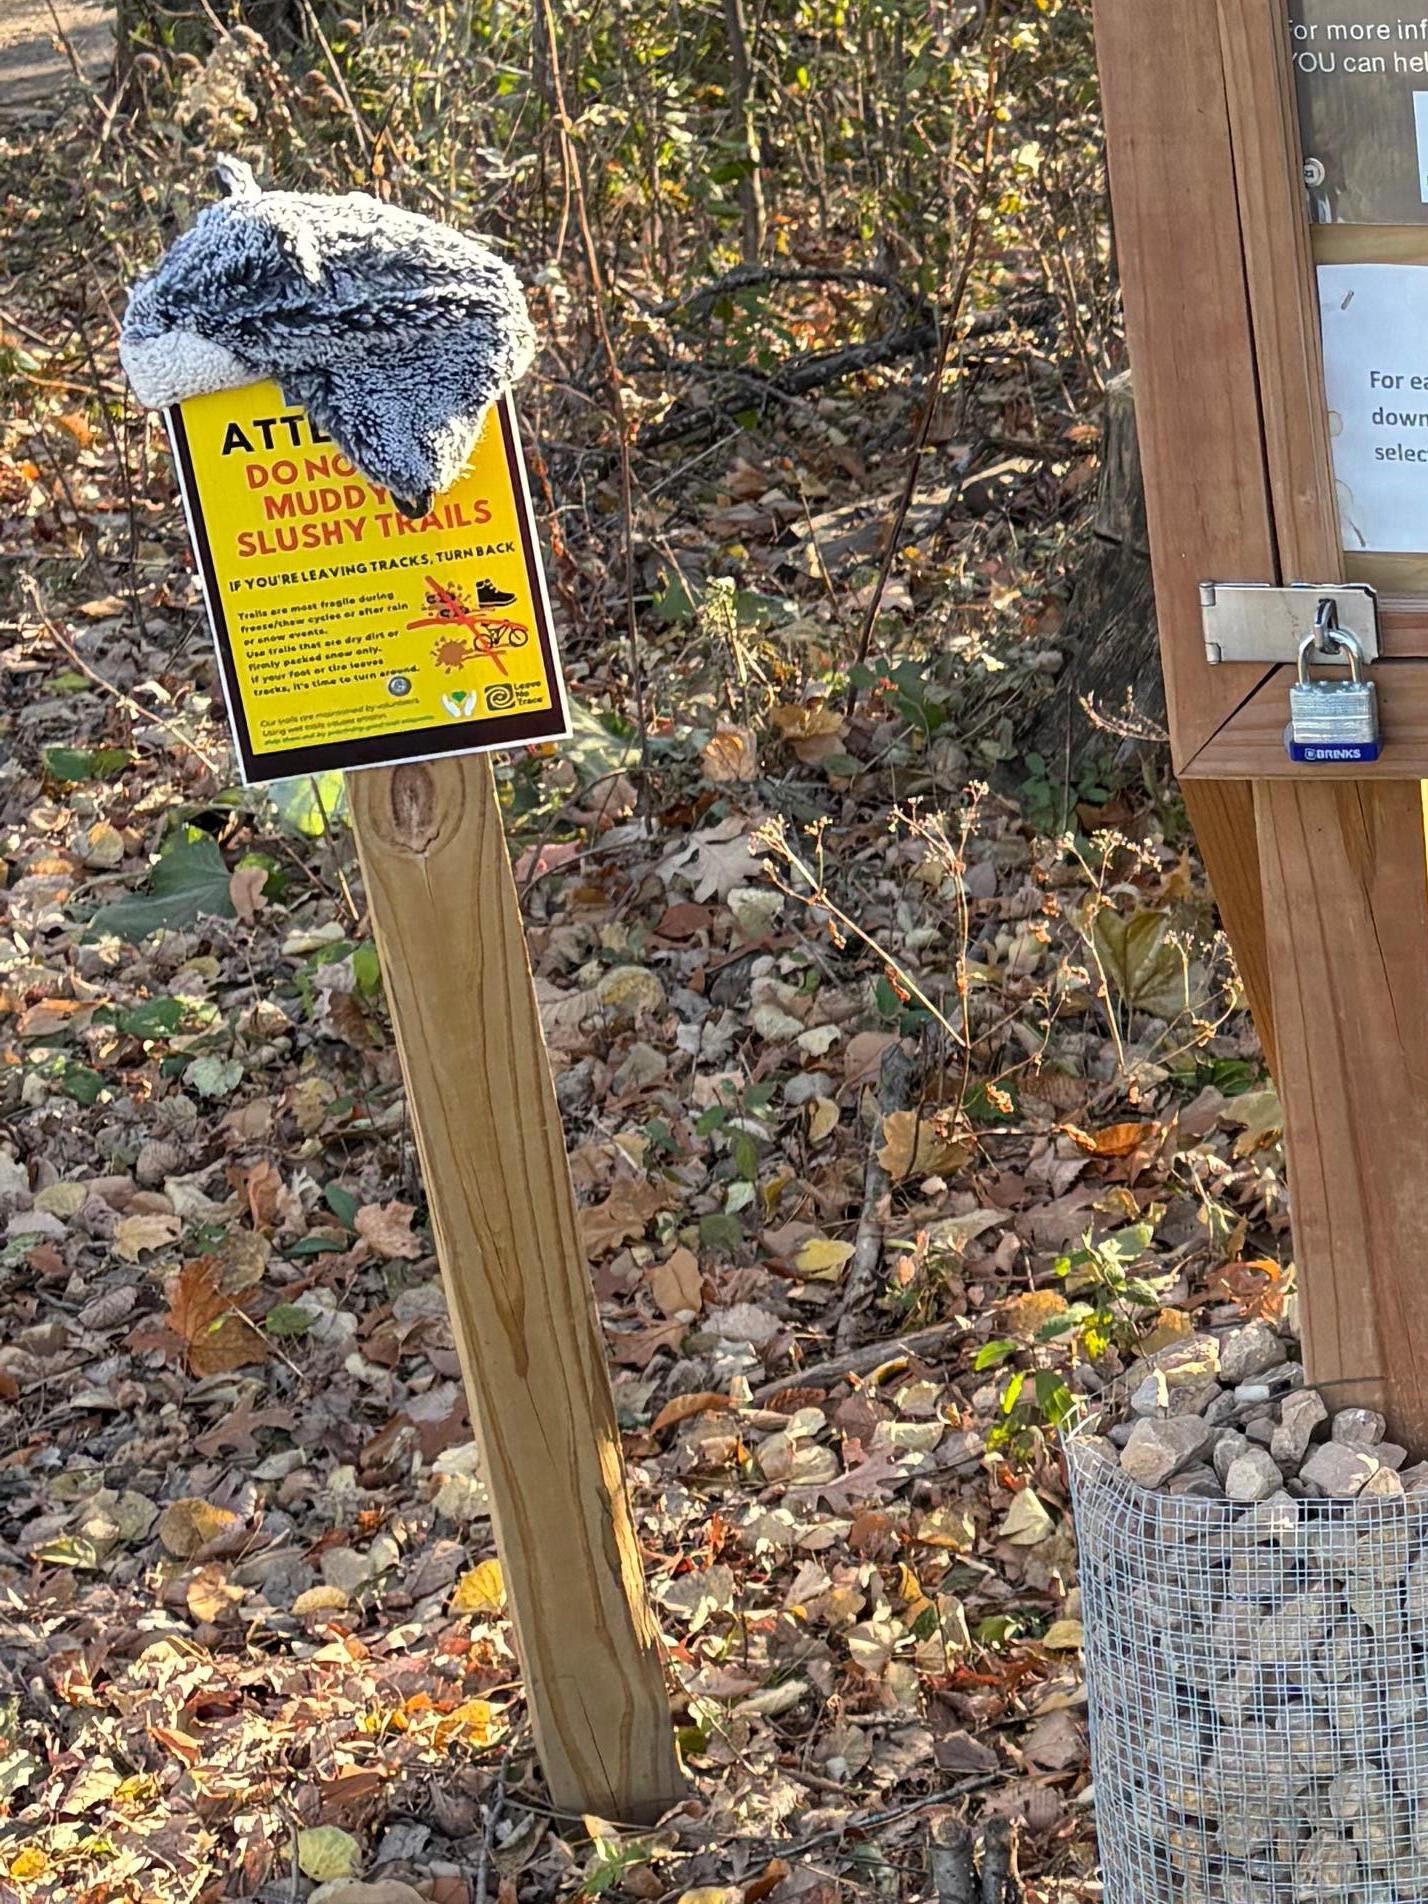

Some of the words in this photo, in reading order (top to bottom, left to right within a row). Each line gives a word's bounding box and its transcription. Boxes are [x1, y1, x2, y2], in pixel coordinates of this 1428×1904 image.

[1292, 53, 1337, 74] OU
[1343, 56, 1386, 73] can
[1369, 370, 1405, 390] For
[246, 459, 299, 490] DO
[304, 452, 358, 482] NO
[264, 484, 387, 521] MUDDY
[237, 516, 367, 557] SLUSHY
[374, 499, 493, 538] TRAILS
[229, 580, 241, 592] IF
[245, 573, 300, 590] YOU'RE
[301, 562, 367, 583] LEAVING
[369, 554, 433, 573] TRACKS,
[435, 546, 473, 563] TURN
[476, 541, 516, 558] BACK
[359, 591, 394, 604] during
[387, 602, 409, 612] rain
[514, 680, 542, 692] Leave
[516, 695, 543, 706] Trace
